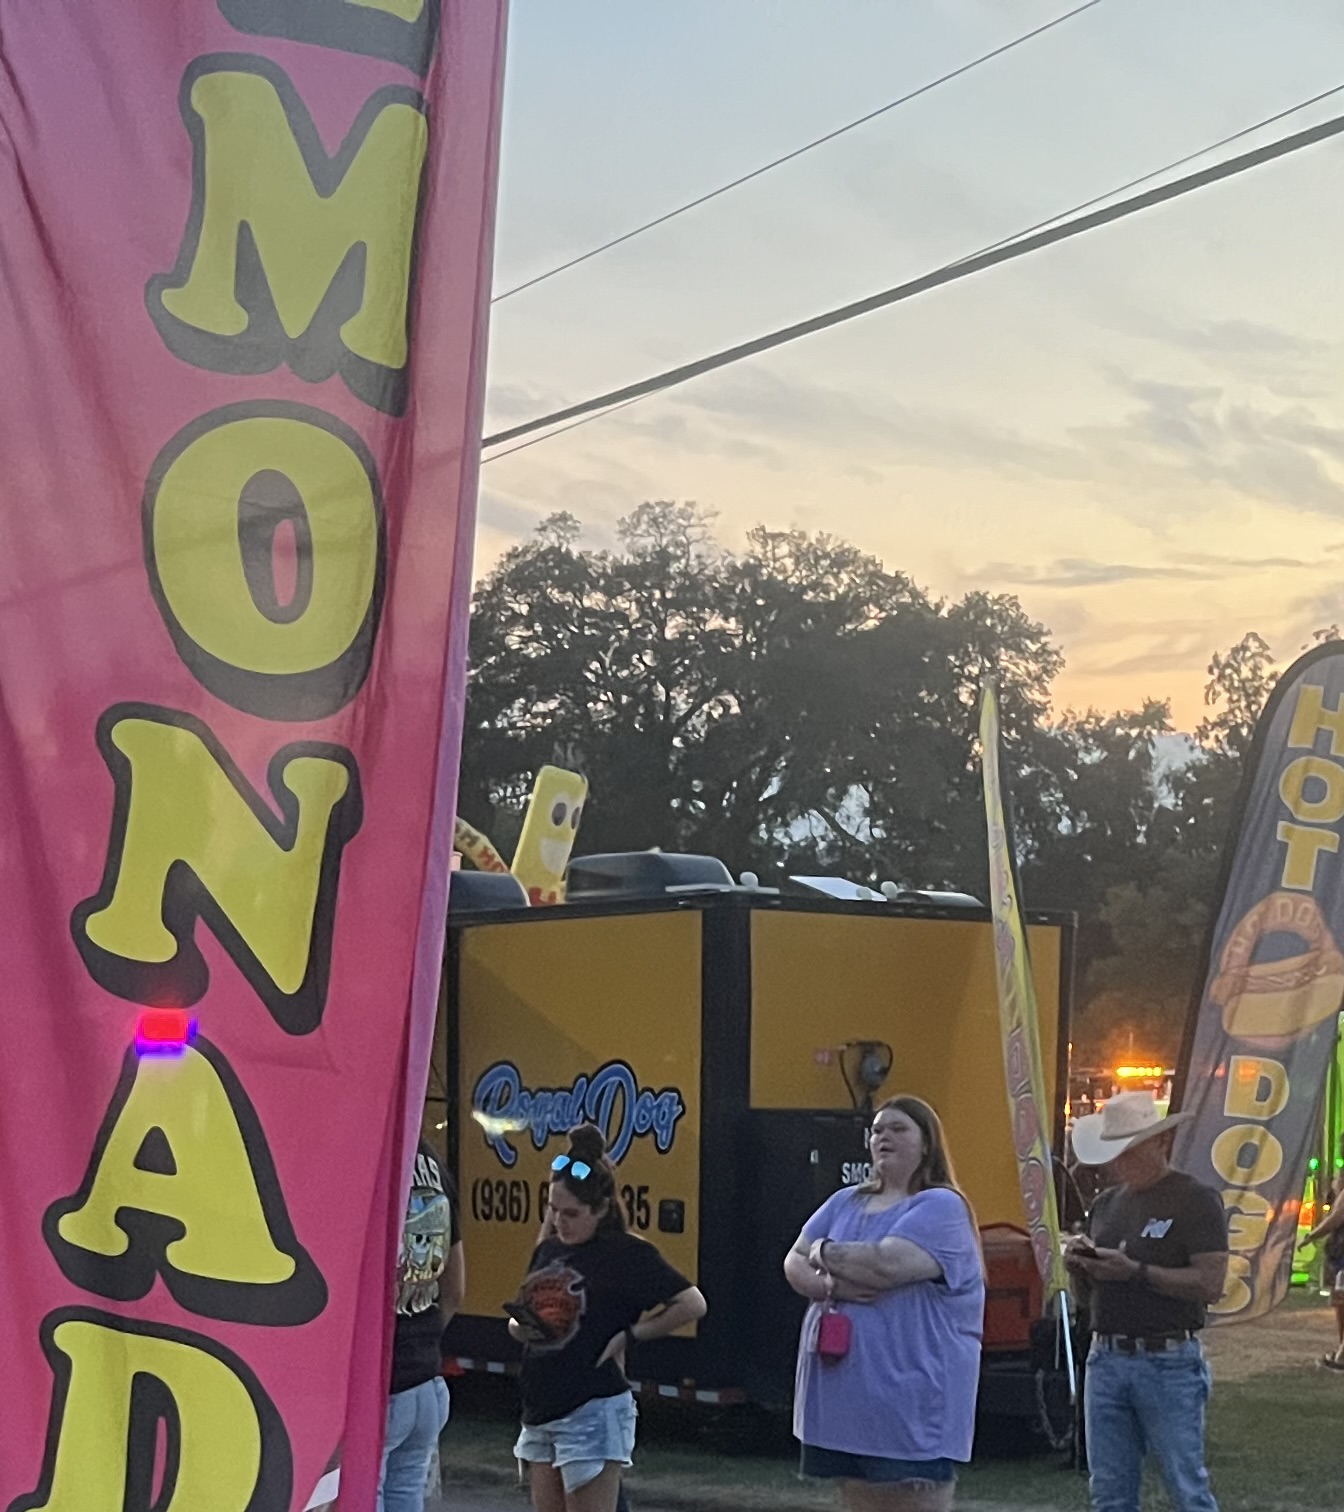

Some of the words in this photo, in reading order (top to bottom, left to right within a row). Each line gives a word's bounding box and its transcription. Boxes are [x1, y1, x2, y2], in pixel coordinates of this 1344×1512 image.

[472, 1060, 590, 1168] Royal
[583, 1059, 686, 1166] Dog
[471, 1178, 531, 1224] (936)
[1207, 1054, 1290, 1315] DOGS
